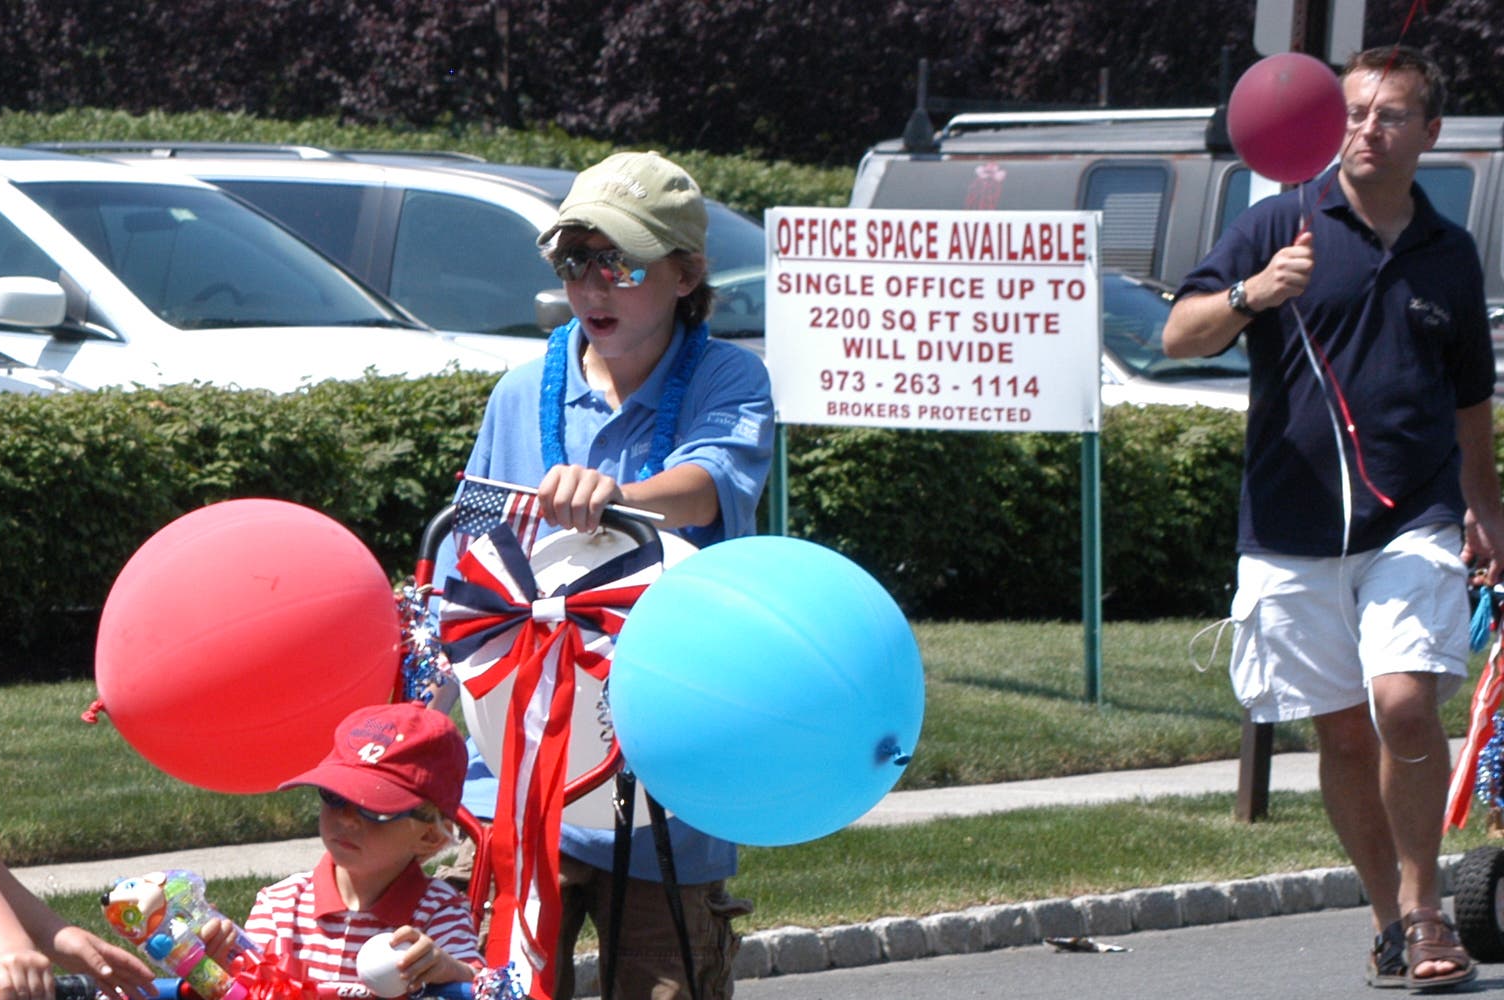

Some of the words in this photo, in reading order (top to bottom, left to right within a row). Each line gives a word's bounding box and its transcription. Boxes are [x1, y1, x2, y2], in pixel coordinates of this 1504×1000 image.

[777, 217, 858, 258] OFFICE
[866, 220, 939, 260] SPACE
[948, 222, 1087, 263] AVAILABLE
[777, 273, 875, 297] SINGLE
[885, 276, 985, 300] OFFICE
[997, 278, 1036, 301] UP
[1048, 279, 1086, 302] TO
[809, 307, 871, 330] 2200
[882, 309, 918, 333] SQ
[928, 311, 961, 333] FT
[972, 312, 1060, 335] SUITE
[843, 338, 906, 361] WILL
[917, 340, 1014, 364] DIVIDE
[820, 370, 866, 393] 973
[893, 372, 941, 396] 263
[971, 376, 1040, 398] 1114
[827, 402, 911, 419] BROKERS
[918, 405, 1032, 423] PROTECTED
[357, 742, 385, 764] 42
